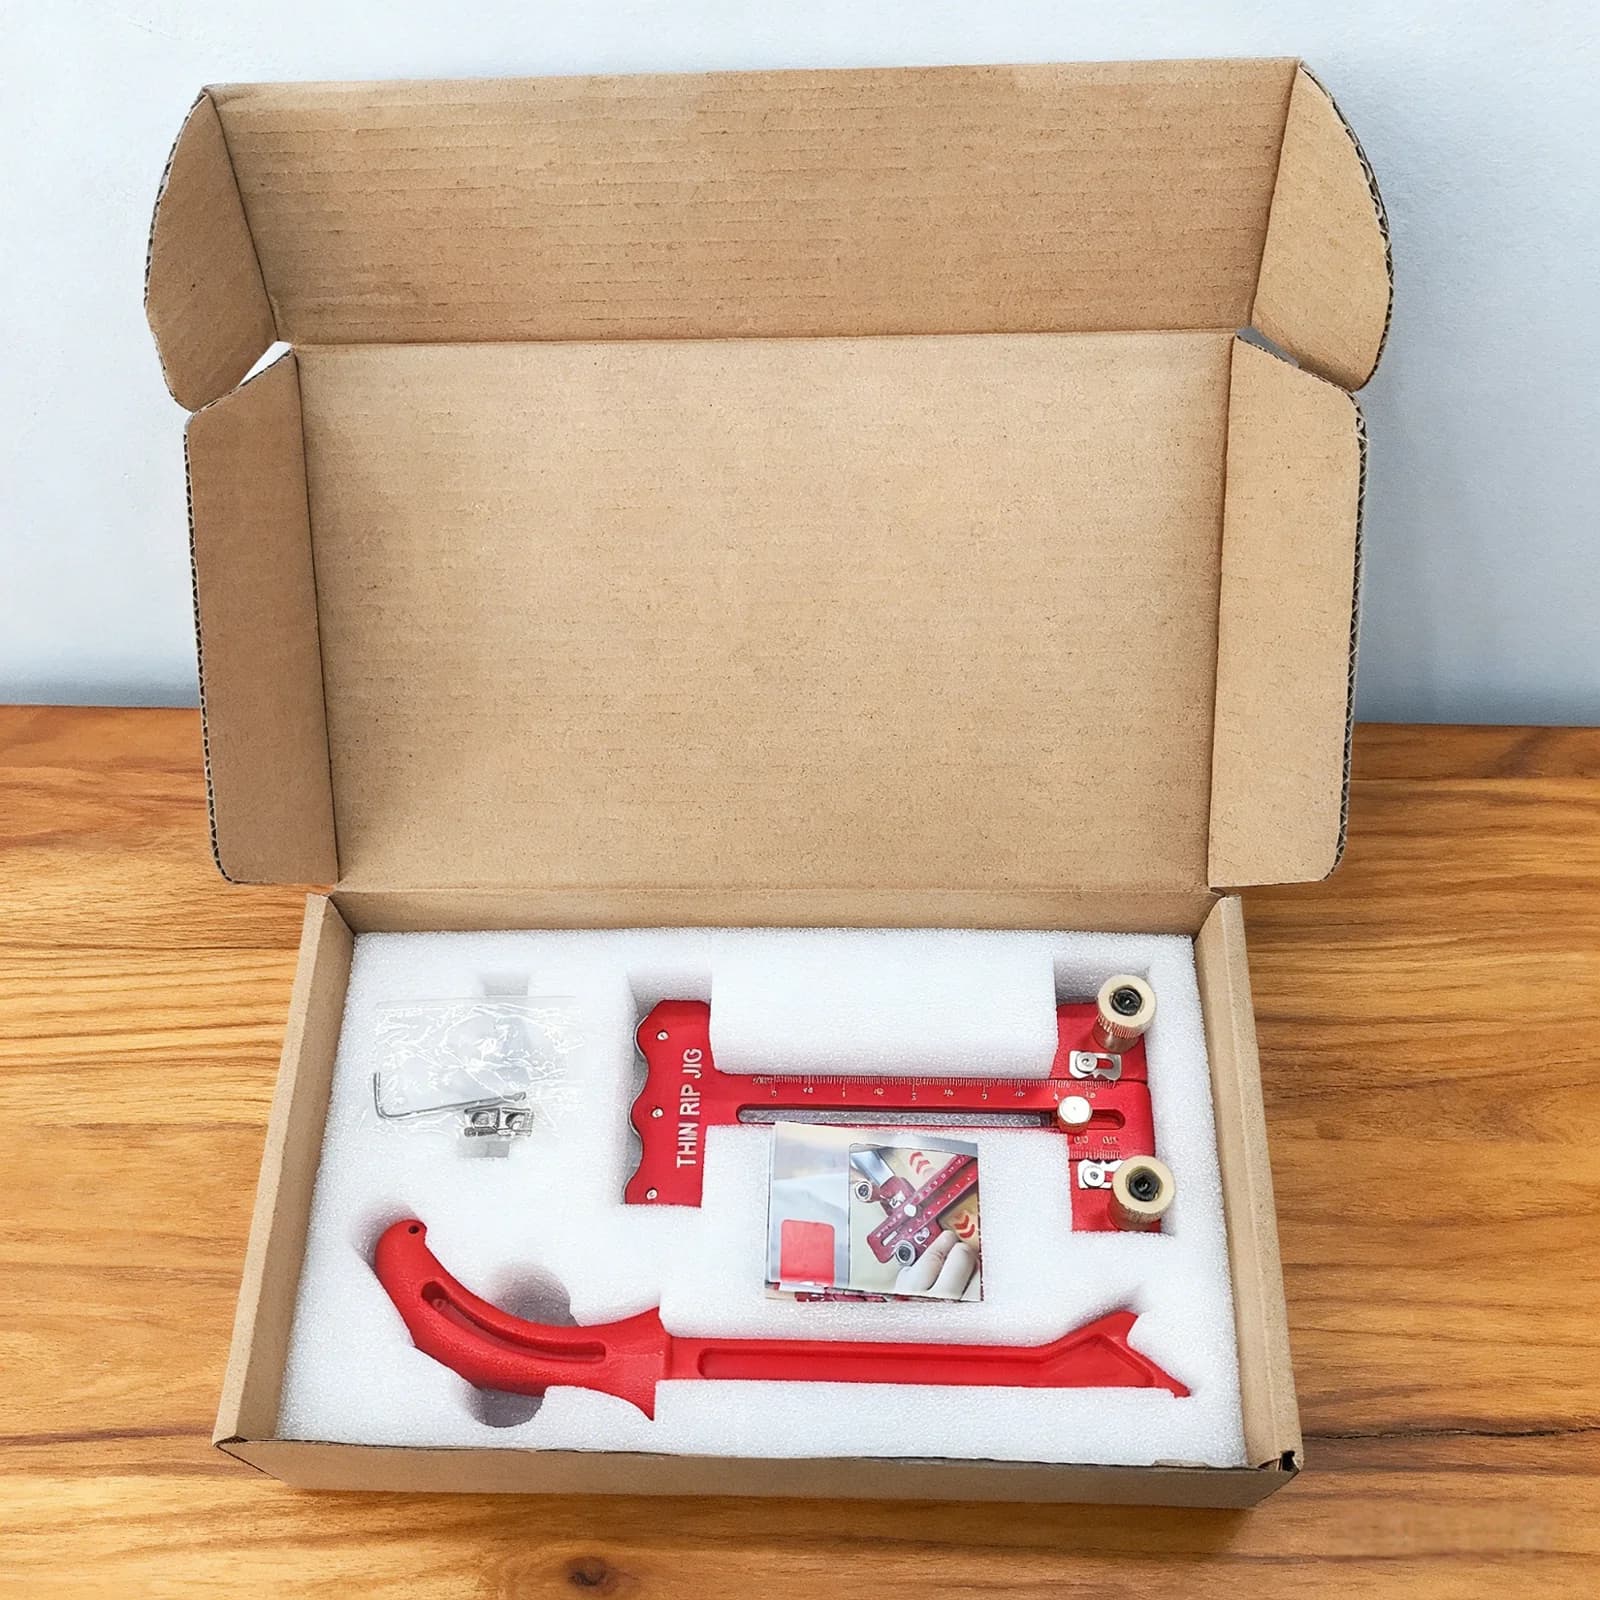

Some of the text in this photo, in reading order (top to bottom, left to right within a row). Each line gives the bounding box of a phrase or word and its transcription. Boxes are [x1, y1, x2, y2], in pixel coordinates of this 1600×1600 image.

[676, 1048, 702, 1168] THIN RIP JIG
